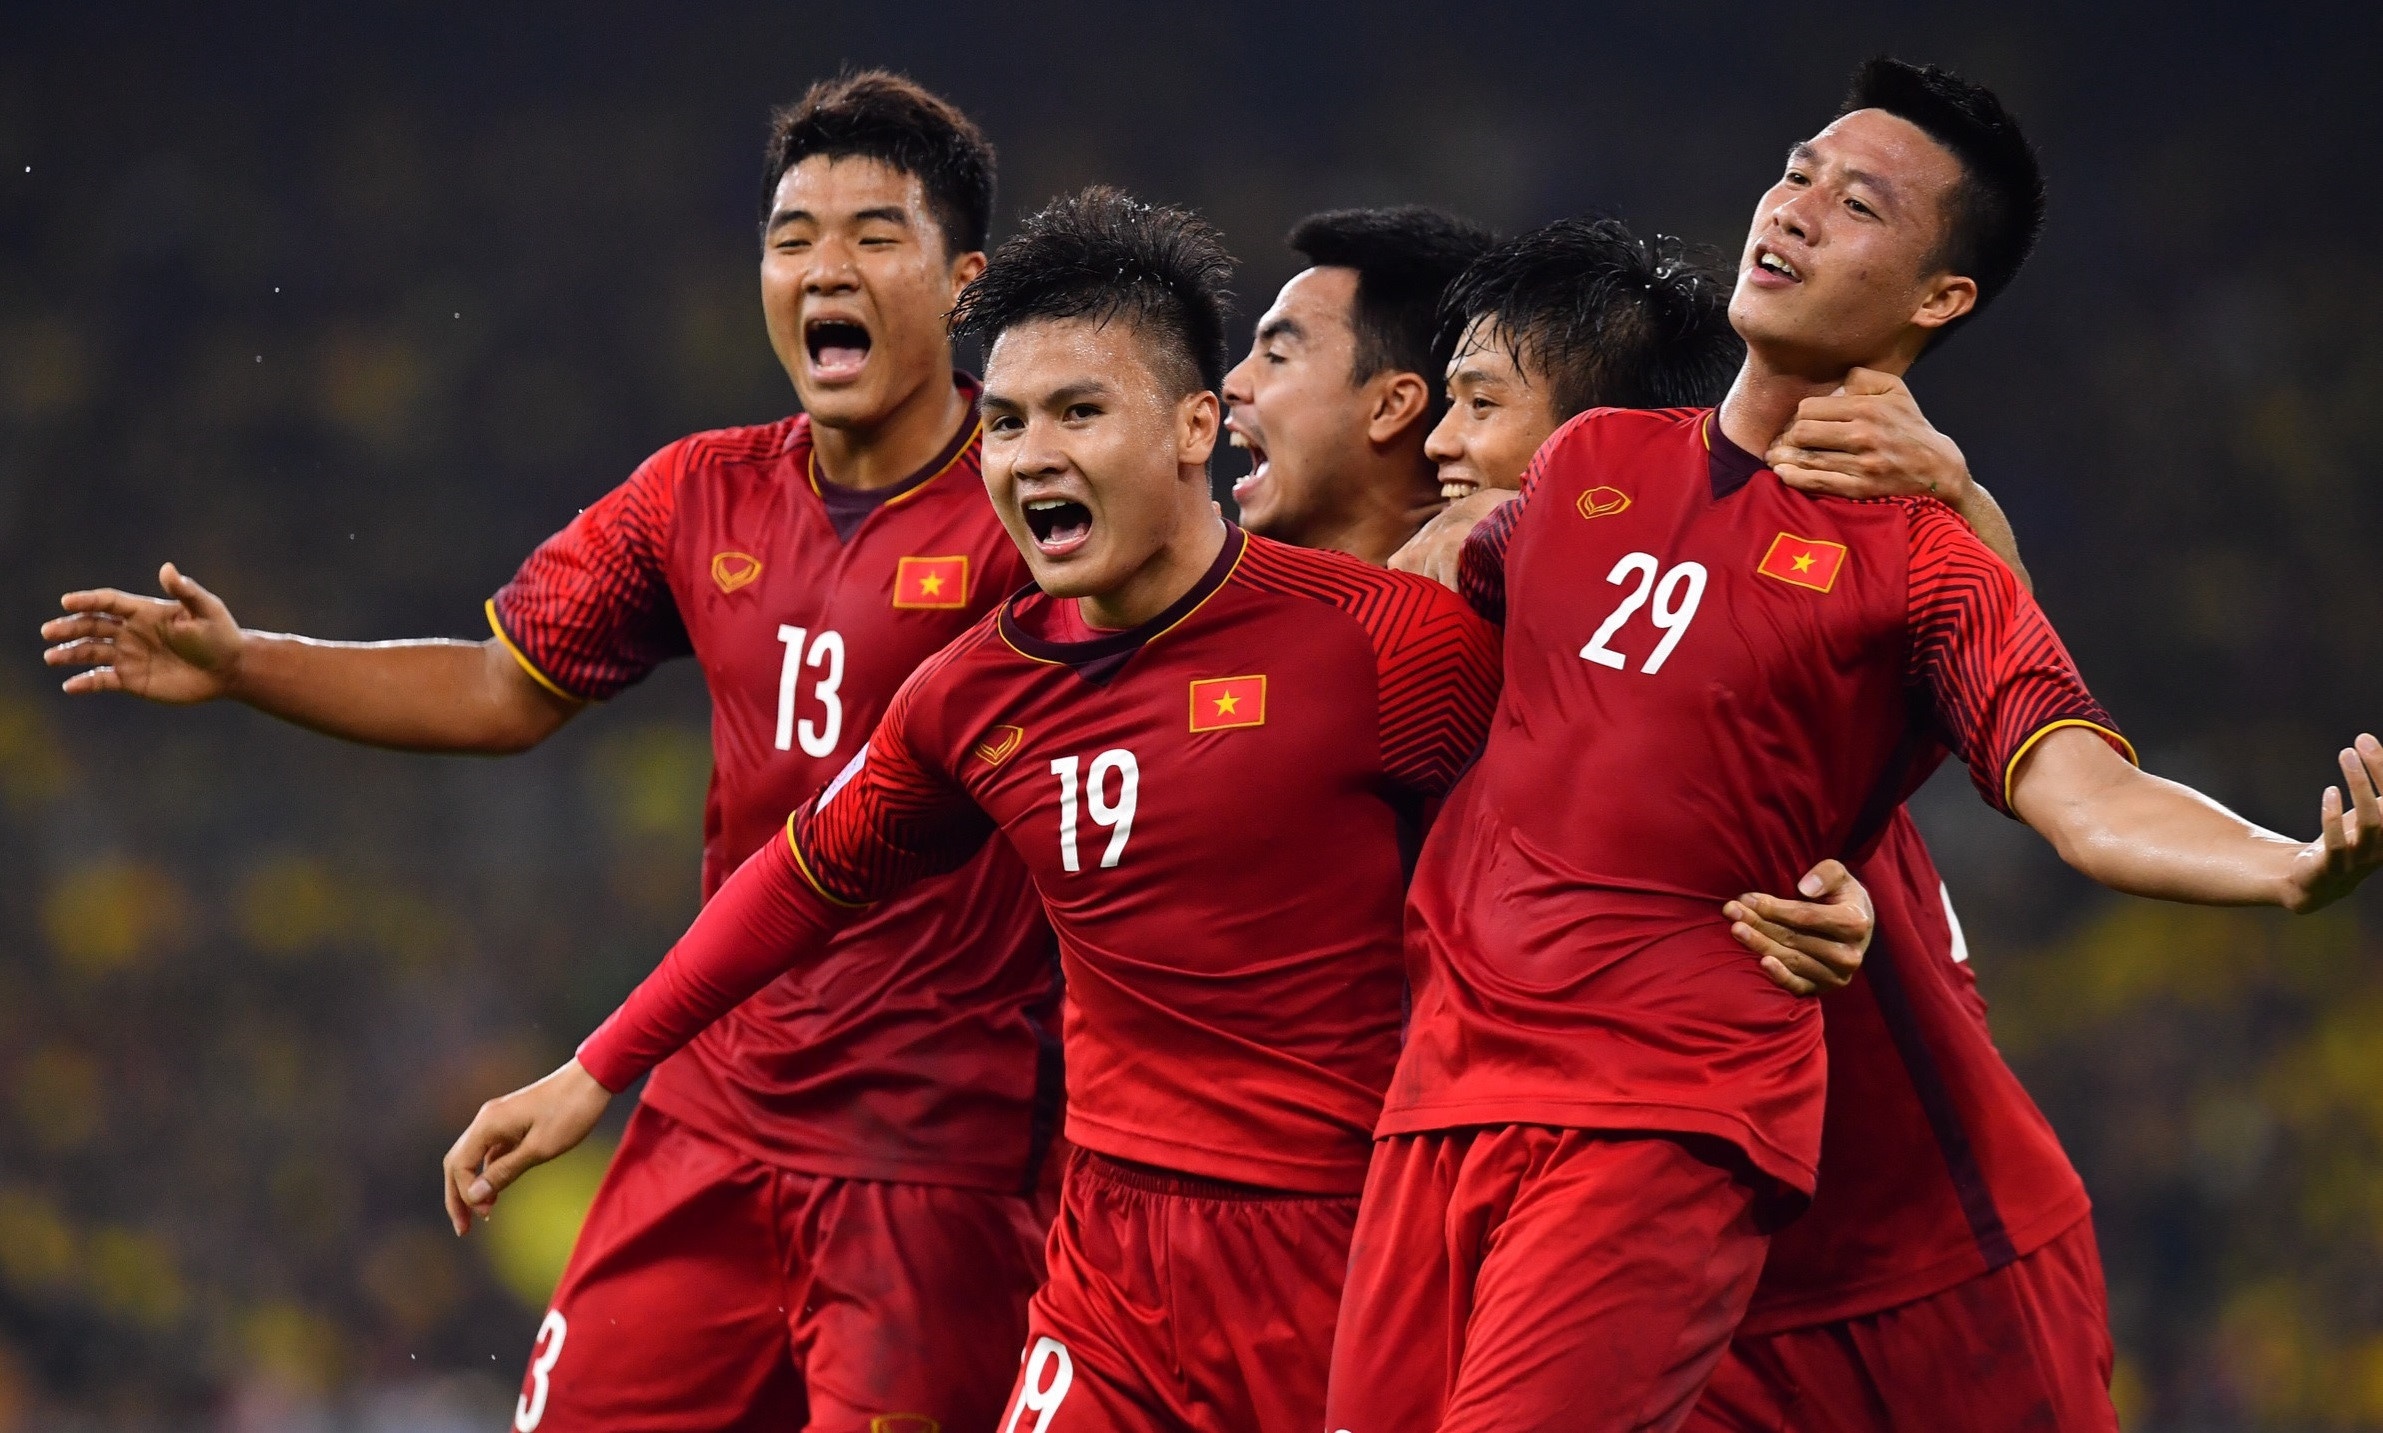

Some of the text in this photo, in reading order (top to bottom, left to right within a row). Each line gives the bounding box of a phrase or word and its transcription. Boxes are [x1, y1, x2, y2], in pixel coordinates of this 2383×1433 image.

[1579, 551, 1708, 675] 29
[775, 624, 845, 758] 13
[1050, 748, 1140, 872] 19
